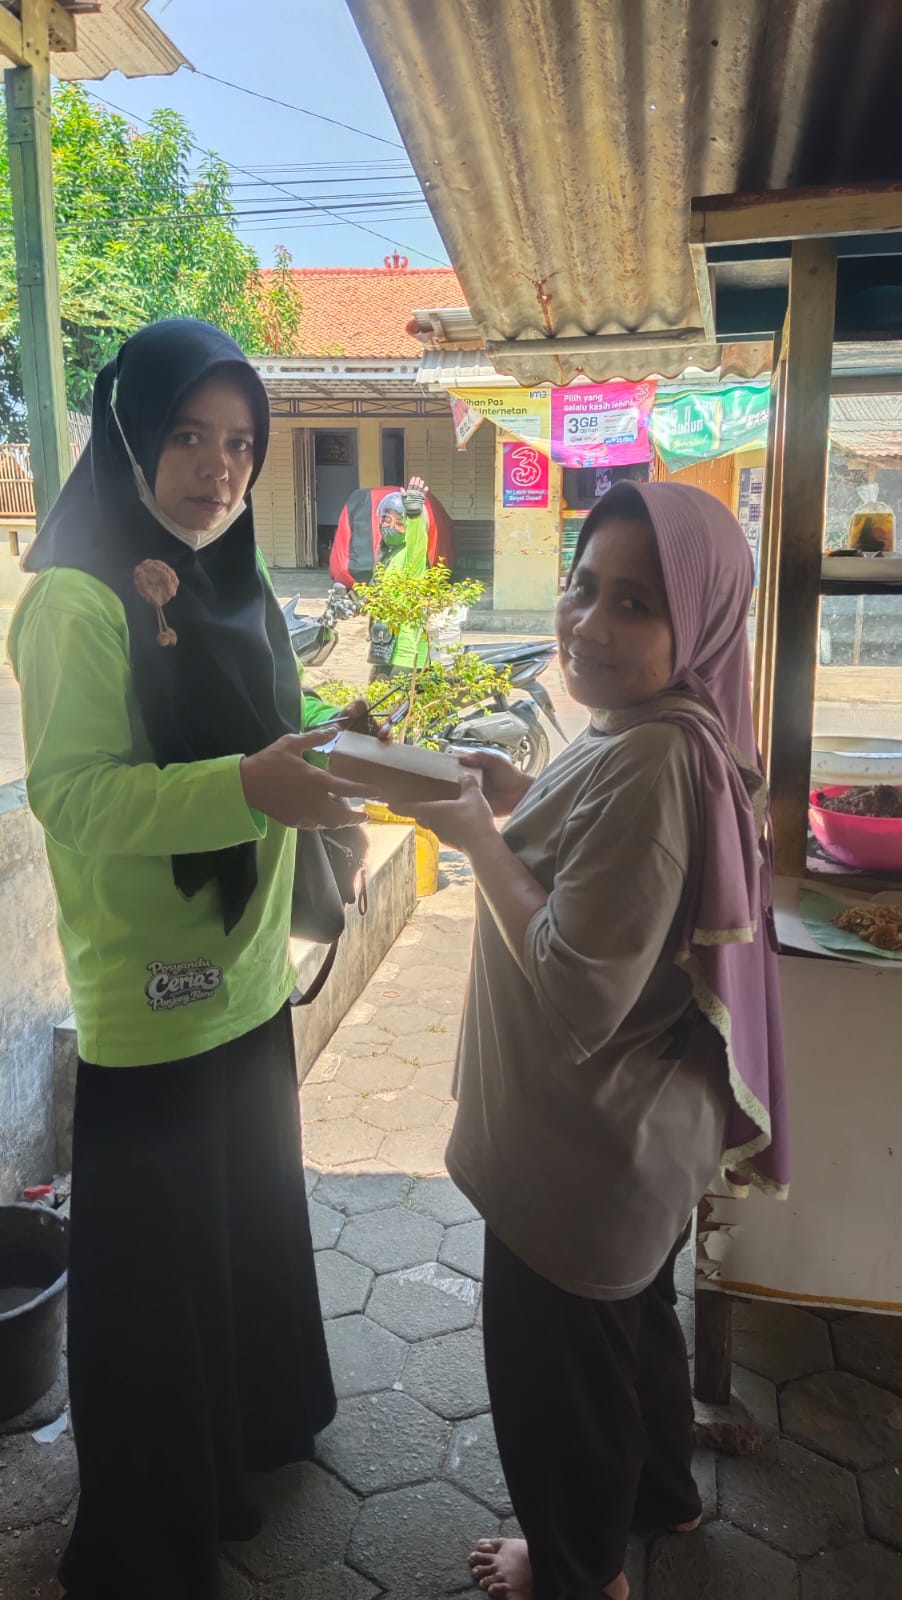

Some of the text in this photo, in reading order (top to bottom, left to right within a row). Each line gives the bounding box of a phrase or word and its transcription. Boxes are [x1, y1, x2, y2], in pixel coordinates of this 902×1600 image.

[487, 398, 504, 406] Pas
[563, 394, 603, 403] Pilih yang
[479, 407, 527, 415] Internetan
[563, 403, 587, 411] selalu
[589, 402, 610, 410] kasih
[568, 417, 579, 434] 3
[579, 416, 598, 428] GB
[148, 957, 210, 976] Posyandu
